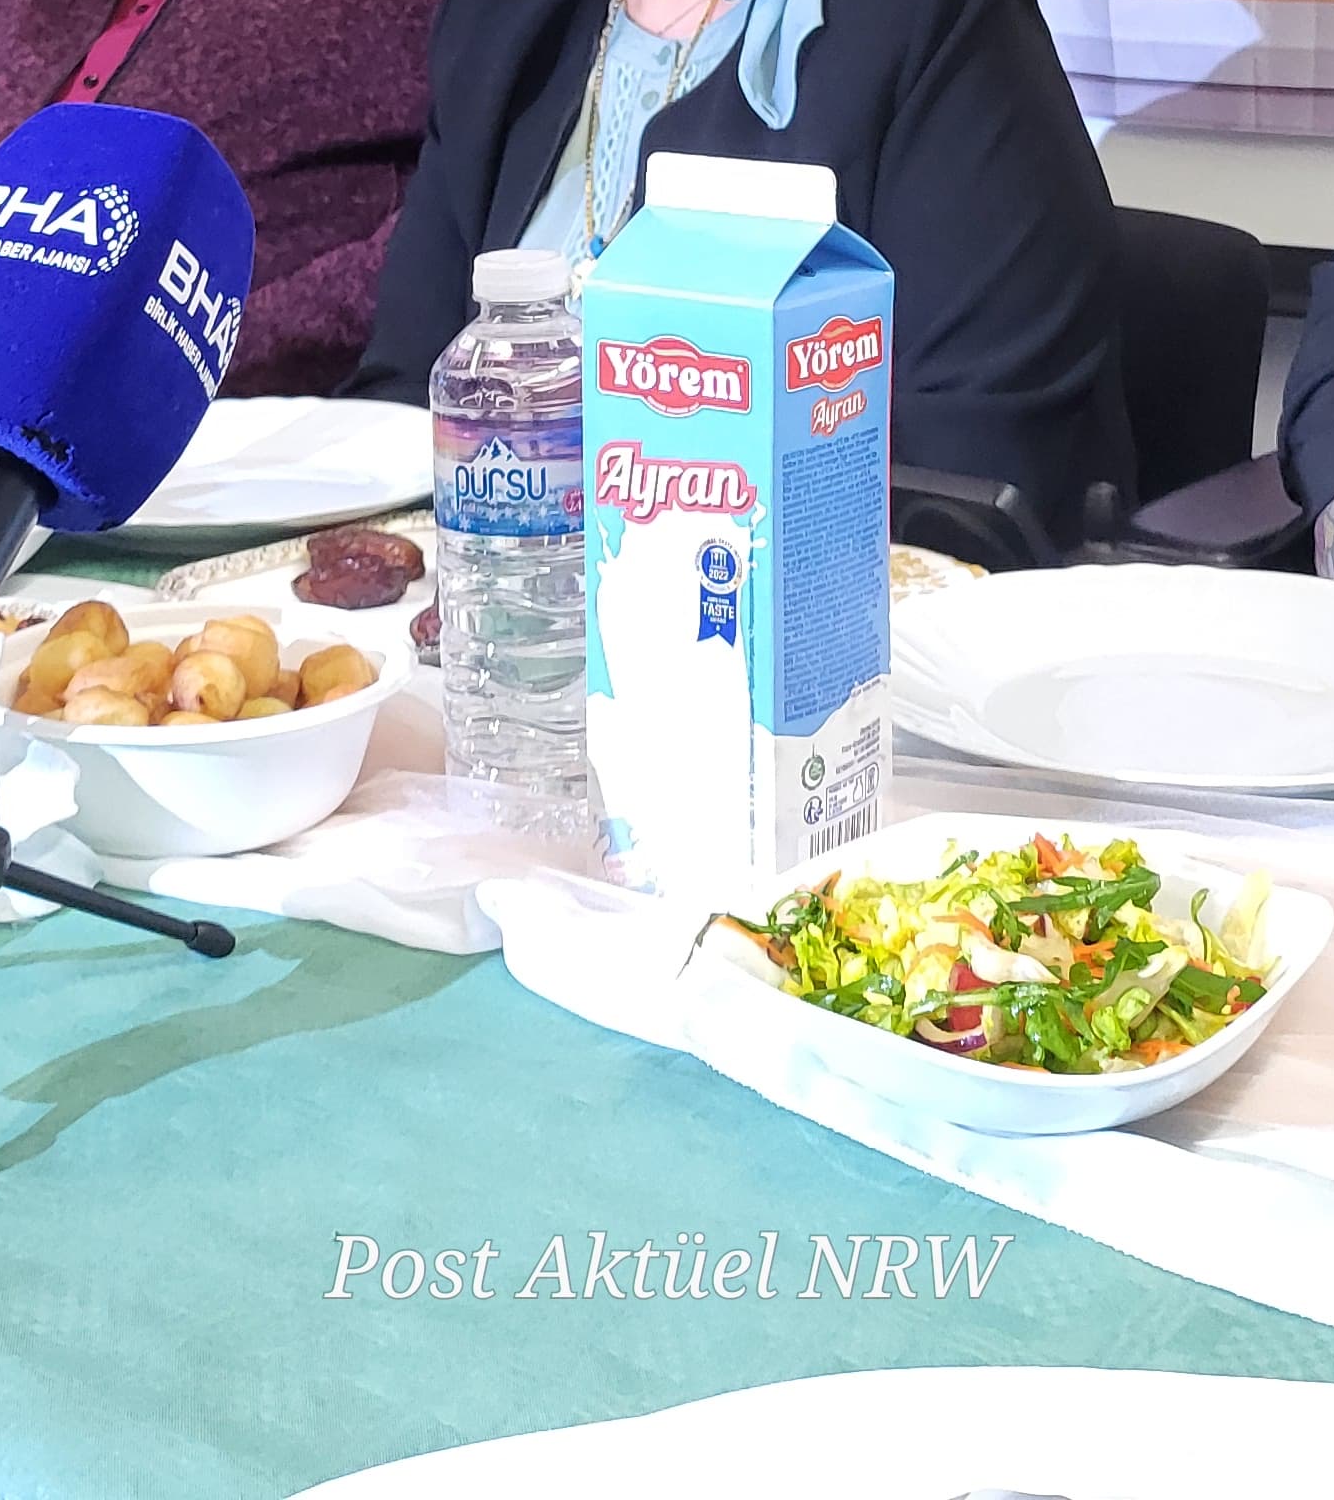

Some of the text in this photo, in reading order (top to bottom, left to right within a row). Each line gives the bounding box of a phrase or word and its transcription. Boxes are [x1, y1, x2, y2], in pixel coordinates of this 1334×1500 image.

[30, 245, 91, 275] AJANSI
[158, 238, 235, 369] BHA
[143, 294, 179, 340] BİRLİK
[174, 327, 202, 370] HABER
[792, 331, 880, 380] Yörem
[605, 346, 743, 403] Yörem
[812, 393, 866, 433] Ayran
[597, 446, 749, 517] Ayran
[708, 568, 729, 581] 2022
[701, 601, 735, 621] TASTE
